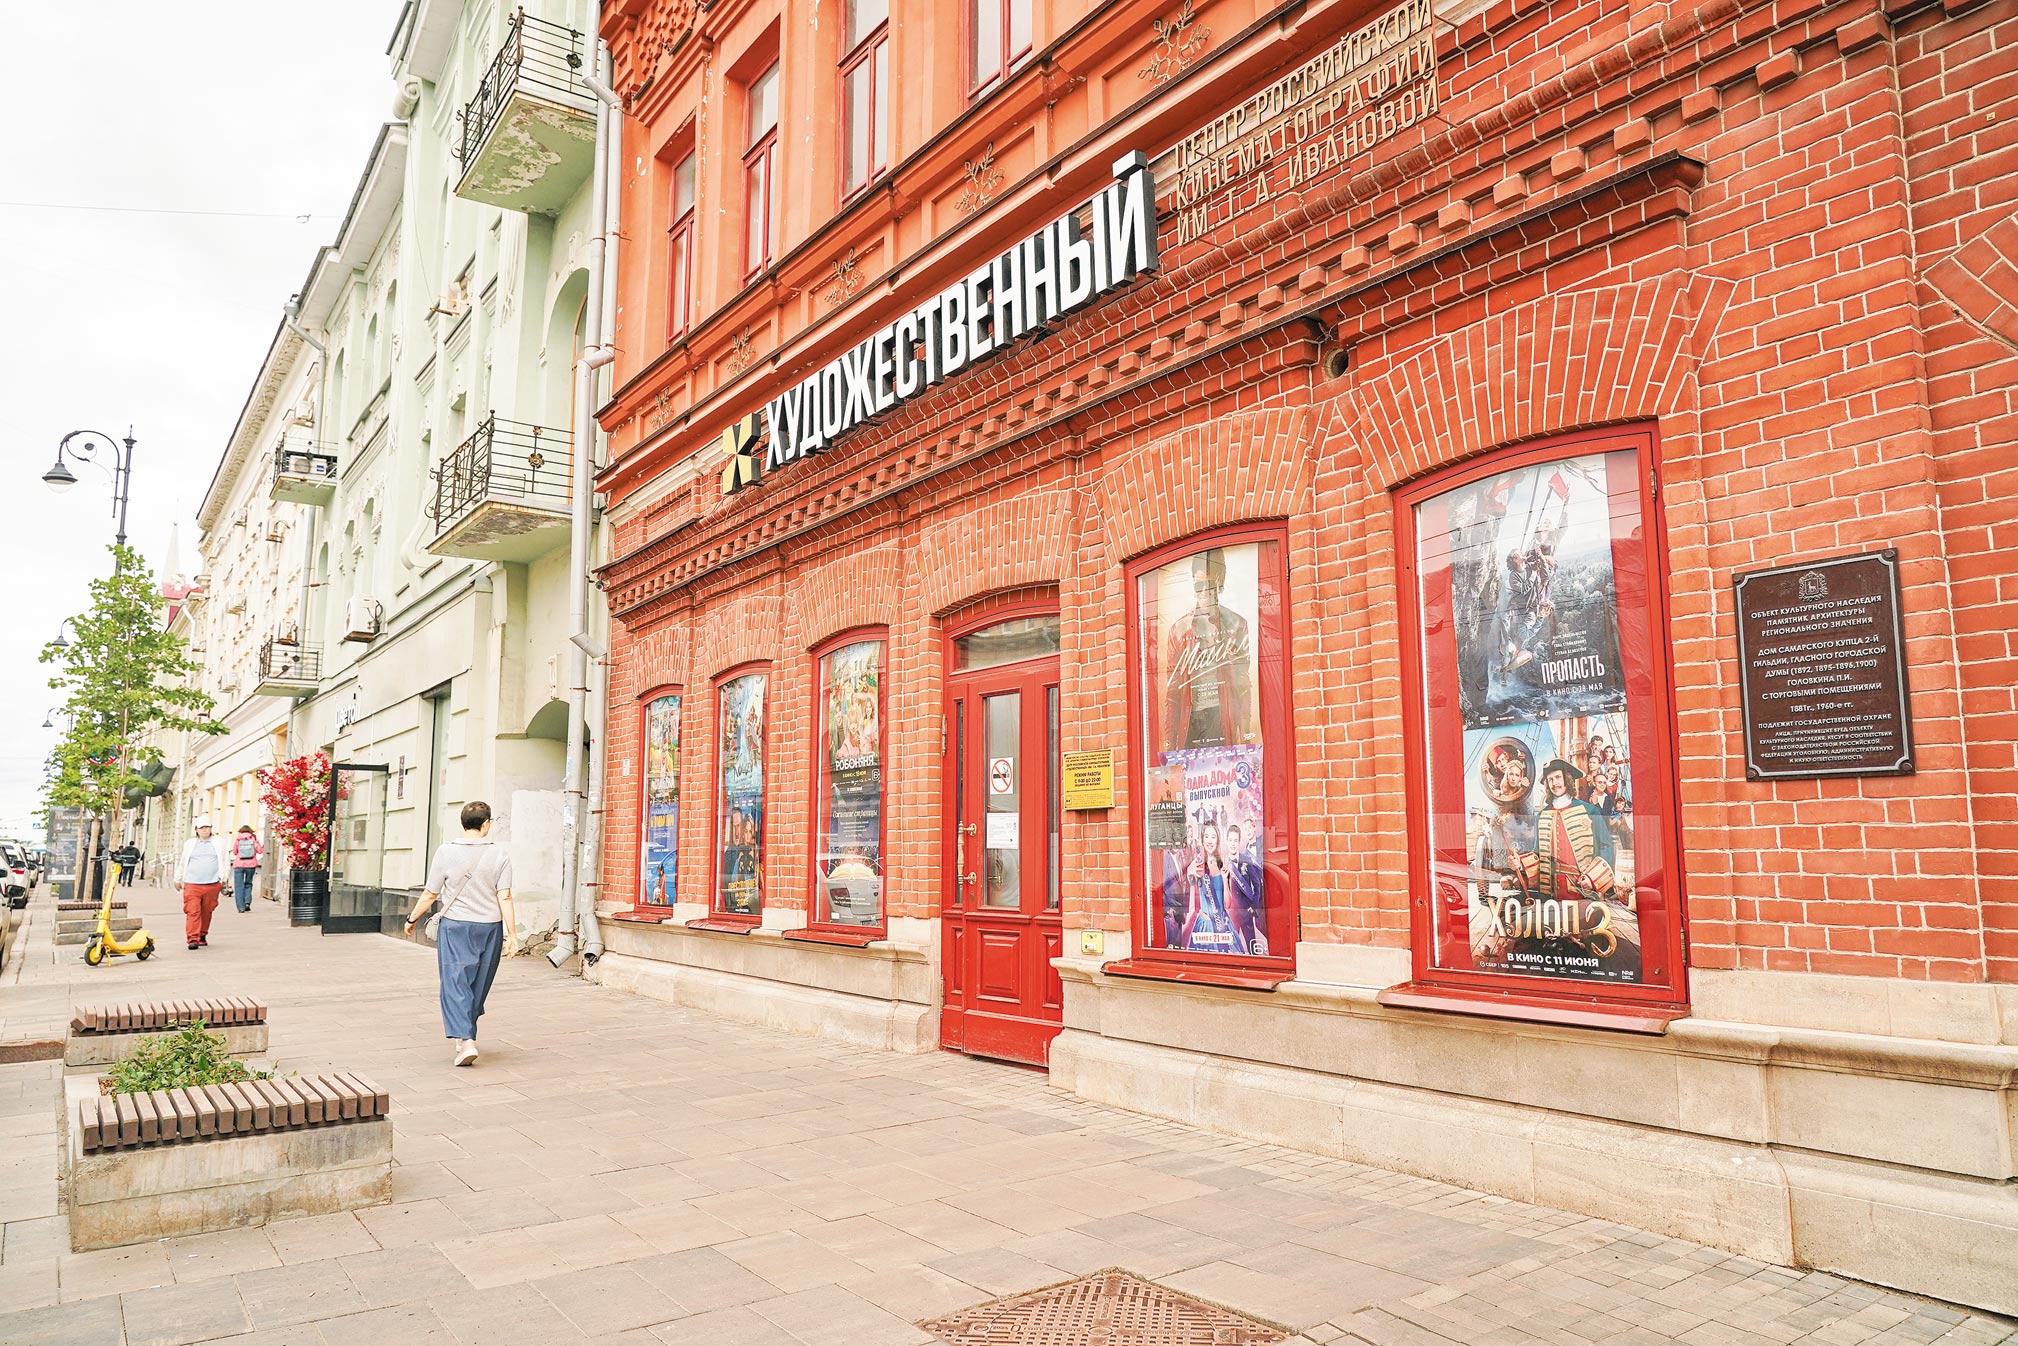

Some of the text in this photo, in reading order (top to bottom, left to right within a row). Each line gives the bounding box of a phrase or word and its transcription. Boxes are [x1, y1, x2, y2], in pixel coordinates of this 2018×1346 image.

[1175, 33, 1436, 210] КИНЕМАТОГРАФИИ
[1174, 104, 1246, 174] ЦЕНТР
[1177, 72, 1440, 247] ИМ. Т. А. ИВАНОВОЙ
[765, 149, 1158, 472] ХУДОЖЕСТВЕННЫЙ
[1751, 594, 1882, 619] ОБЪЕКТ КУЛЬТУРНОГО НАСЛЕДИЯ
[1761, 616, 1873, 637] РЕГИОНАЛЬНОГО ЗНАЧЕНИЯ
[1766, 607, 1865, 627] ПАМЯТНИК АРХИТЕКТУРЫ
[1758, 634, 1879, 657] ДОМ САМАРСКОГО КУПЦА 2-Й
[1753, 645, 1887, 668] ГИЛЬДИИ, ГЛАСНОГО ГОРОДСКОЙ
[1541, 654, 1605, 684] ПРОПАСТЬ
[1765, 668, 1789, 679] ДУМЫ
[1552, 687, 1570, 696] КИНО
[1588, 682, 1604, 691] МАЯ
[1787, 674, 1853, 687] ГОЛОВКИНА П.И.
[1762, 682, 1882, 700] С ТОРГОВЫМИ ПОМЕЩЕНИЯМИ
[1758, 713, 1892, 729] ПОДЛЕЖИТ ГОСУДАРСТВЕННОЙ ОХРАНЕ
[835, 754, 875, 771] РОБОНЯНЯ
[1186, 761, 1251, 790] ОДНА ДОМА 3
[1189, 785, 1230, 801] ВЫПУСКНОЙ
[1150, 802, 1183, 811] ЛУГАНЦЫ
[1487, 896, 1618, 958] ХОЛОП 3
[1213, 934, 1220, 942] 21
[1507, 952, 1599, 968] В КИНО С 11 ИЮНЯ
